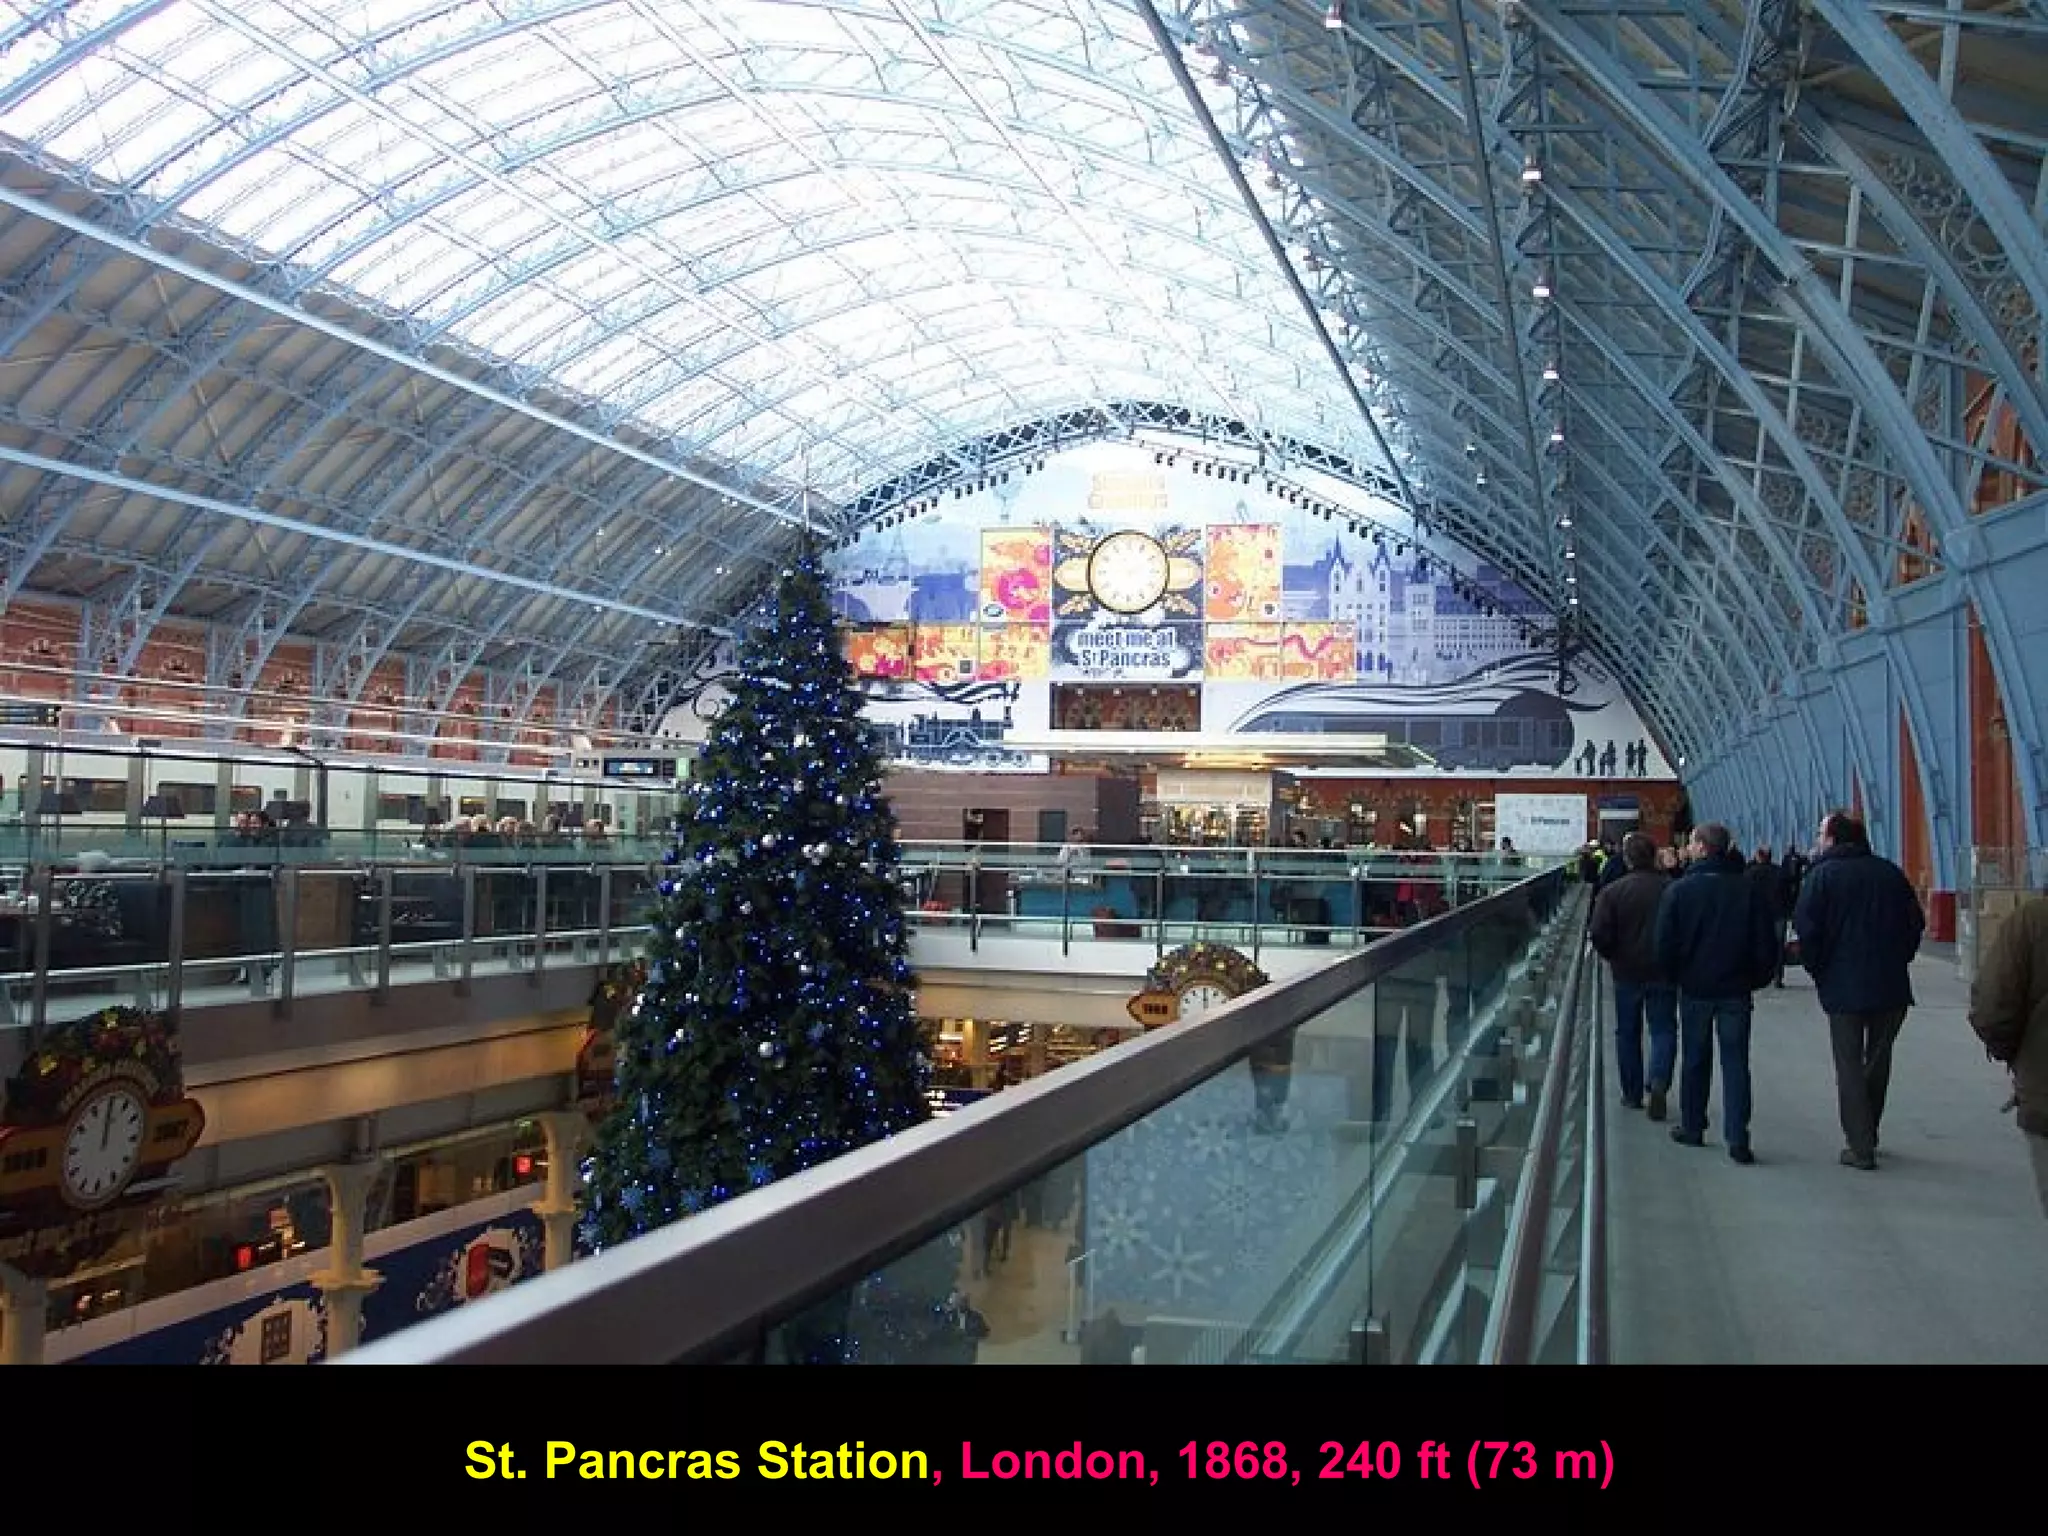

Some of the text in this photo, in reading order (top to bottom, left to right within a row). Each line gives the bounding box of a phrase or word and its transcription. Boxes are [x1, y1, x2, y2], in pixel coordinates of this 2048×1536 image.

[1077, 630, 1174, 648] meet me at
[1100, 649, 1171, 666] Pancras
